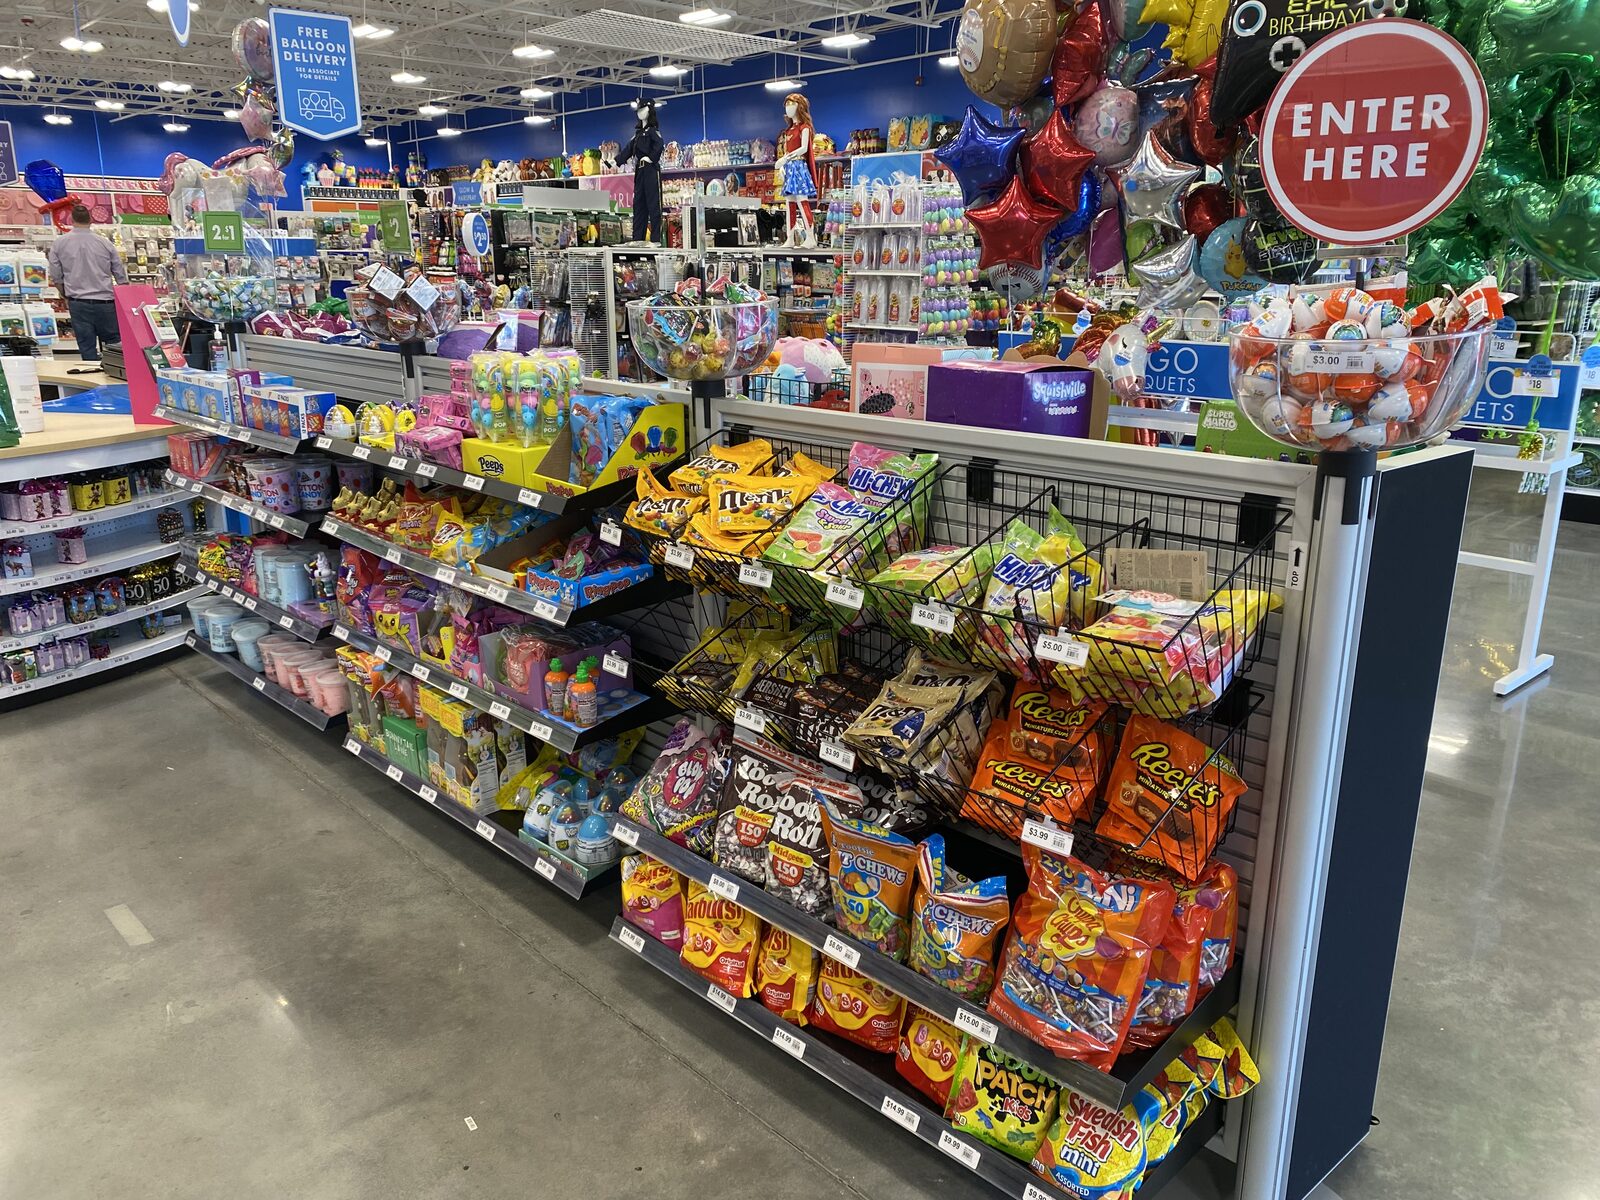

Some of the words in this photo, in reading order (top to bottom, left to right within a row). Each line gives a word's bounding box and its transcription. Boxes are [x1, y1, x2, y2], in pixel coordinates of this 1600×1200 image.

[297, 26, 329, 39] FREE
[281, 37, 346, 54] BALLOON
[283, 51, 347, 67] DELIVERY
[307, 68, 340, 76] ASSOCIATE
[313, 74, 337, 82] DETAILS
[1291, 93, 1451, 138] ENTER
[1303, 141, 1430, 182] HERE
[211, 224, 222, 240] 2
[389, 217, 401, 238] $2
[1312, 355, 1340, 365] $3.00
[1033, 380, 1086, 403] Squishville
[1529, 379, 1542, 389] $18
[1207, 409, 1235, 420] SUPER
[1203, 418, 1237, 430] MARIO
[478, 456, 504, 473] Peeps
[743, 569, 758, 578] $5.00
[1291, 571, 1299, 587] TOP
[126, 584, 145, 599] 50
[154, 576, 170, 594] 50
[831, 586, 847, 596] $6.00
[918, 610, 935, 621] $6.00
[1043, 640, 1063, 653] $5.00
[1014, 691, 1093, 727] Reese's
[1024, 721, 1053, 735] MINIATURE
[1054, 729, 1069, 739] CUPS
[825, 748, 840, 758] $3.99
[986, 758, 1074, 799] Reese's
[1130, 742, 1222, 807] Reese's
[994, 778, 1025, 795] MINIATURE
[771, 812, 822, 850] Roll
[1028, 827, 1049, 841] $3.99
[775, 860, 799, 877] 150
[855, 854, 907, 886] CHEWS
[933, 903, 996, 935] CHEWS
[719, 957, 746, 968] Original
[711, 987, 727, 1000] $14.99
[765, 986, 791, 999] Original
[872, 1020, 898, 1029] Original
[959, 1012, 980, 1028] $15.00
[775, 1029, 792, 1044] $14.99
[976, 1060, 1057, 1113] PATCH
[885, 1100, 905, 1116] $14.99
[1003, 1097, 1033, 1121] Kids
[1066, 1092, 1138, 1150] Swedish
[943, 1134, 961, 1150] $9.99
[1066, 1118, 1113, 1162] Fish
[1061, 1145, 1100, 1177] mini
[1055, 1172, 1090, 1196] ASSORTED
